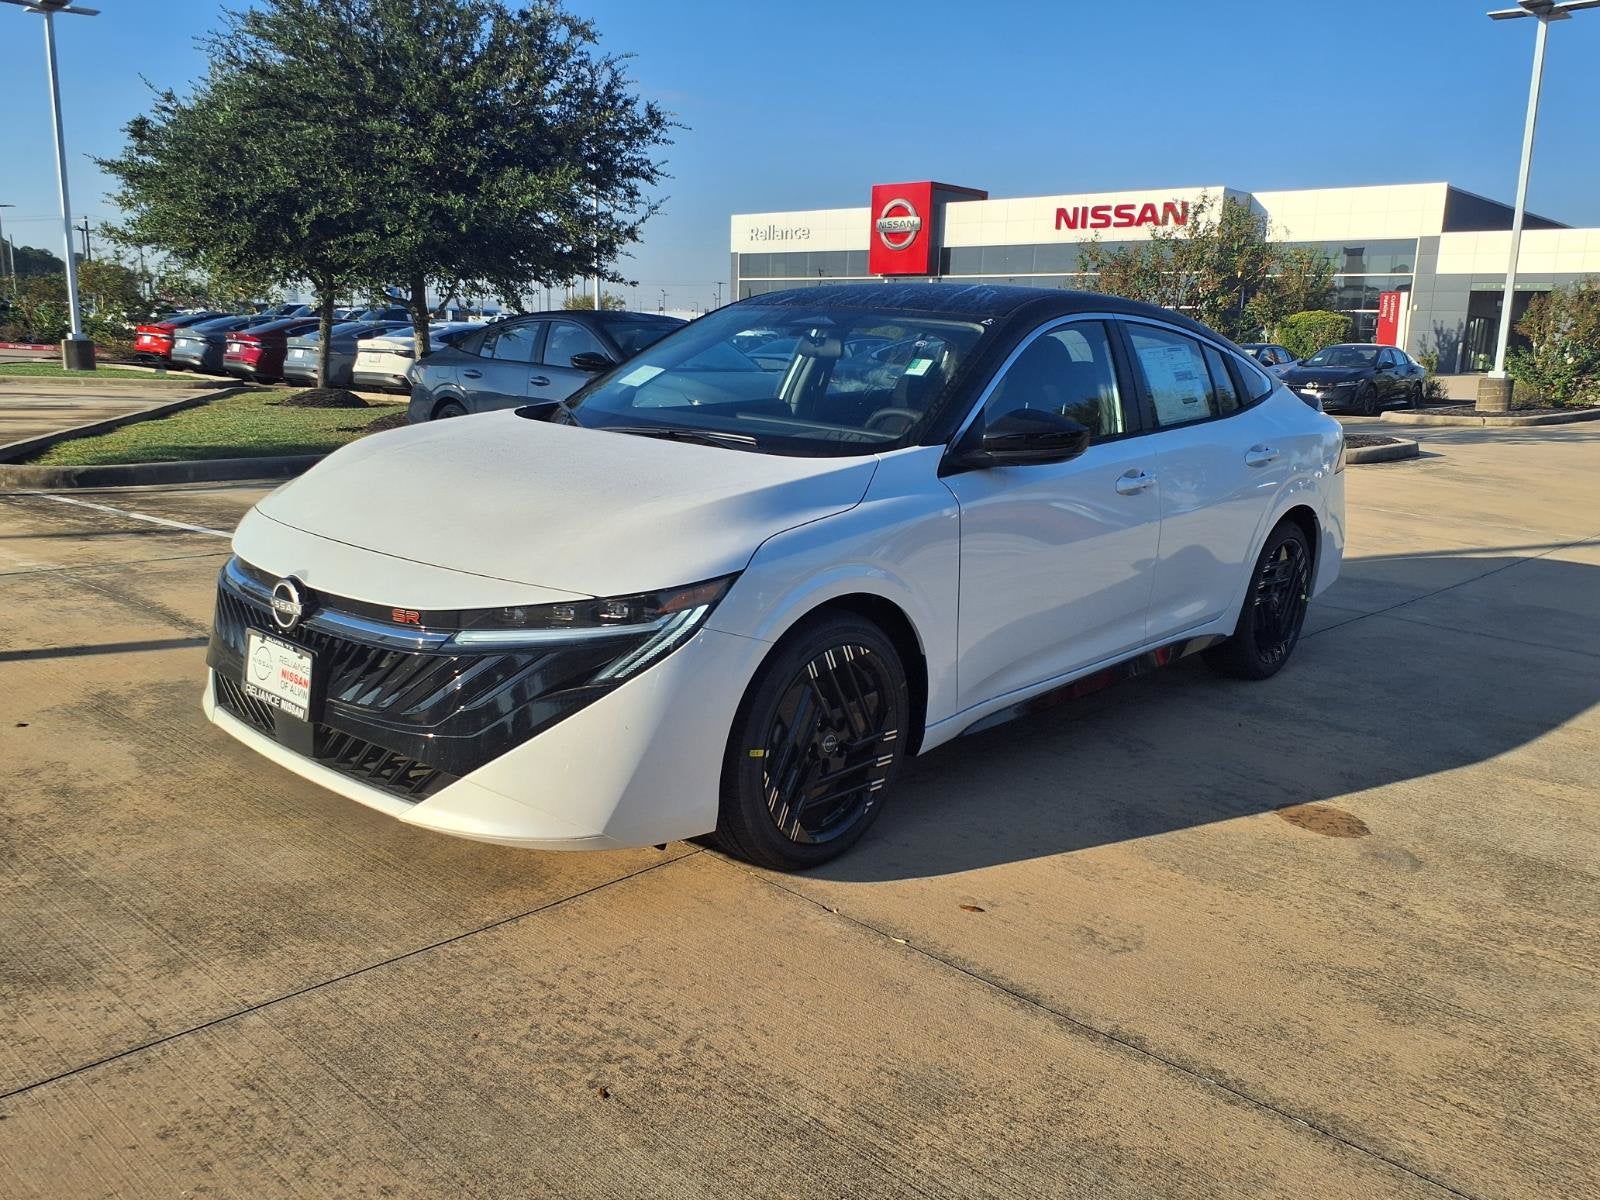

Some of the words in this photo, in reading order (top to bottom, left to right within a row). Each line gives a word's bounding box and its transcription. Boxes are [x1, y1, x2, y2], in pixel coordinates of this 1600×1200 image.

[879, 220, 915, 229] NISSAN
[1055, 200, 1190, 230] NISSAN
[750, 224, 811, 241] Reliance
[392, 608, 420, 624] SR
[253, 656, 273, 671] NISSAN
[279, 654, 310, 675] RELIANCE
[281, 668, 309, 690] NISSAN
[246, 682, 280, 707] RELIANCE
[280, 699, 304, 719] NISSAN
[280, 680, 289, 691] OF
[289, 684, 308, 701] ALVIN
